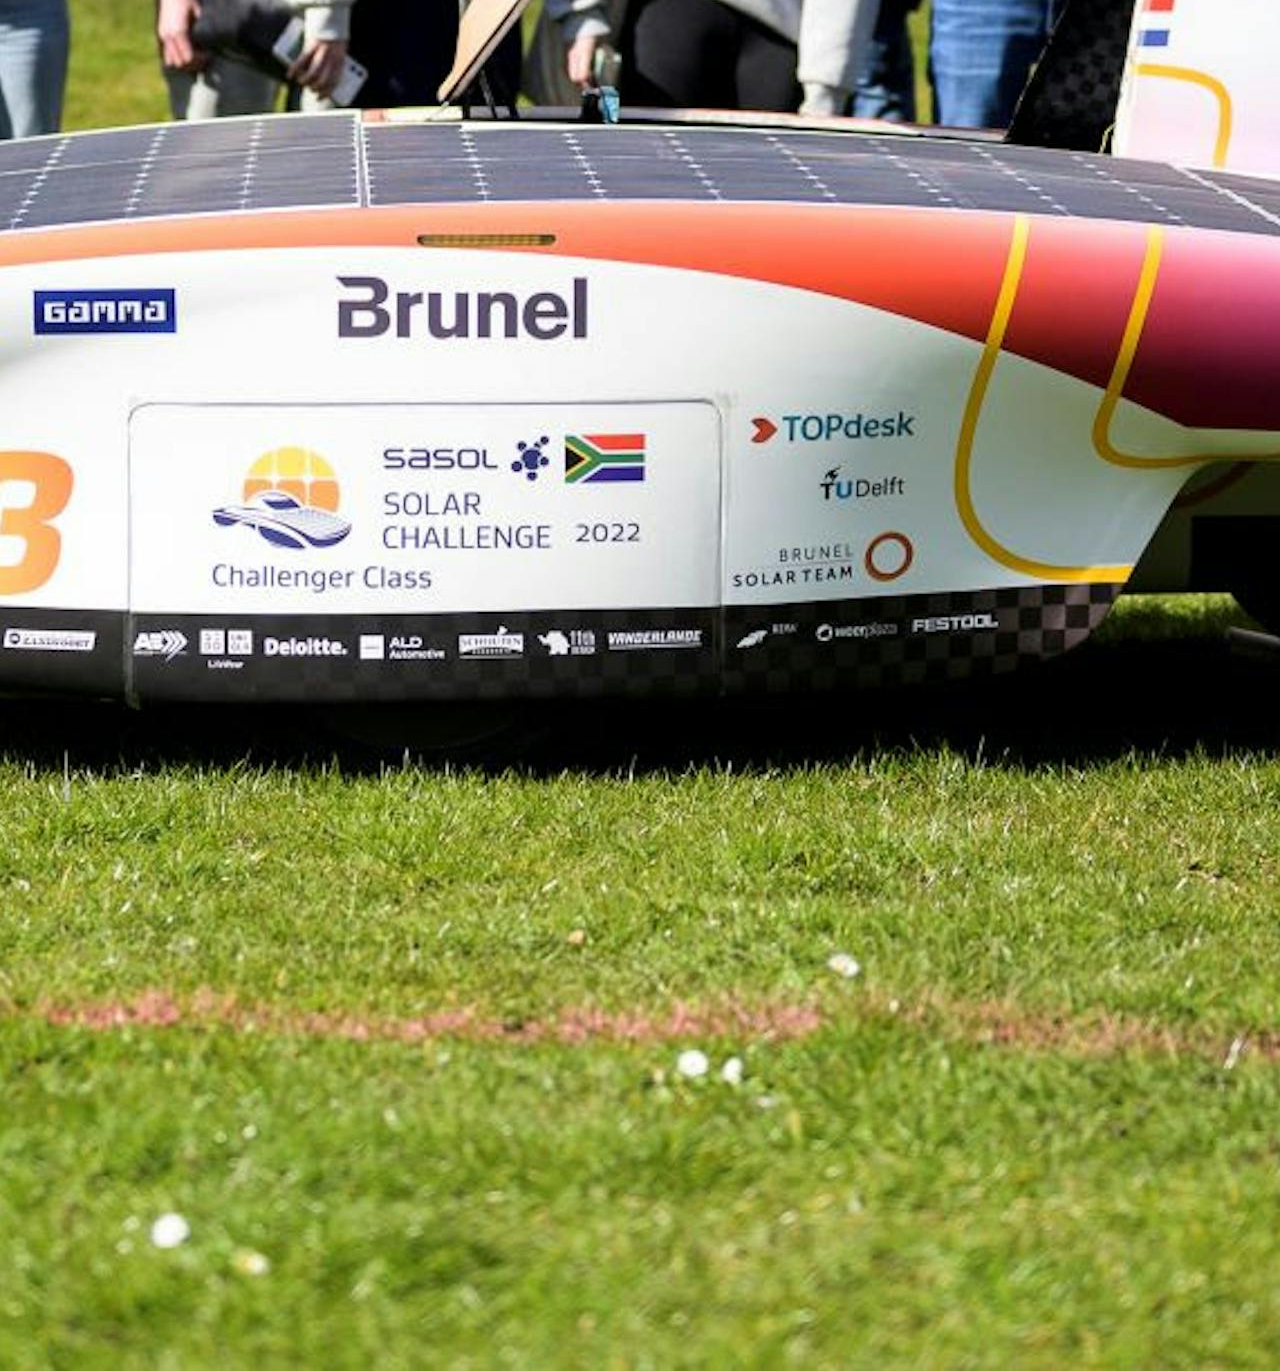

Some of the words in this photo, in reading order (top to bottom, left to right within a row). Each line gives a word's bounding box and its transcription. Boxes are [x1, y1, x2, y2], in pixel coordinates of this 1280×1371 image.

[336, 276, 588, 340] Brunel
[783, 412, 915, 441] TOPdesk
[383, 492, 481, 516] SOLAR
[382, 525, 551, 549] CHALLENGE
[575, 523, 640, 542] 2022
[779, 545, 853, 562] BRUNEL
[212, 563, 355, 593] Challenger
[363, 566, 432, 589] Class
[733, 571, 795, 587] SOLAR
[802, 566, 852, 582] TEAM
[912, 614, 999, 632] FESTOOL
[389, 636, 422, 648] ALD
[389, 649, 445, 660] Automotive
